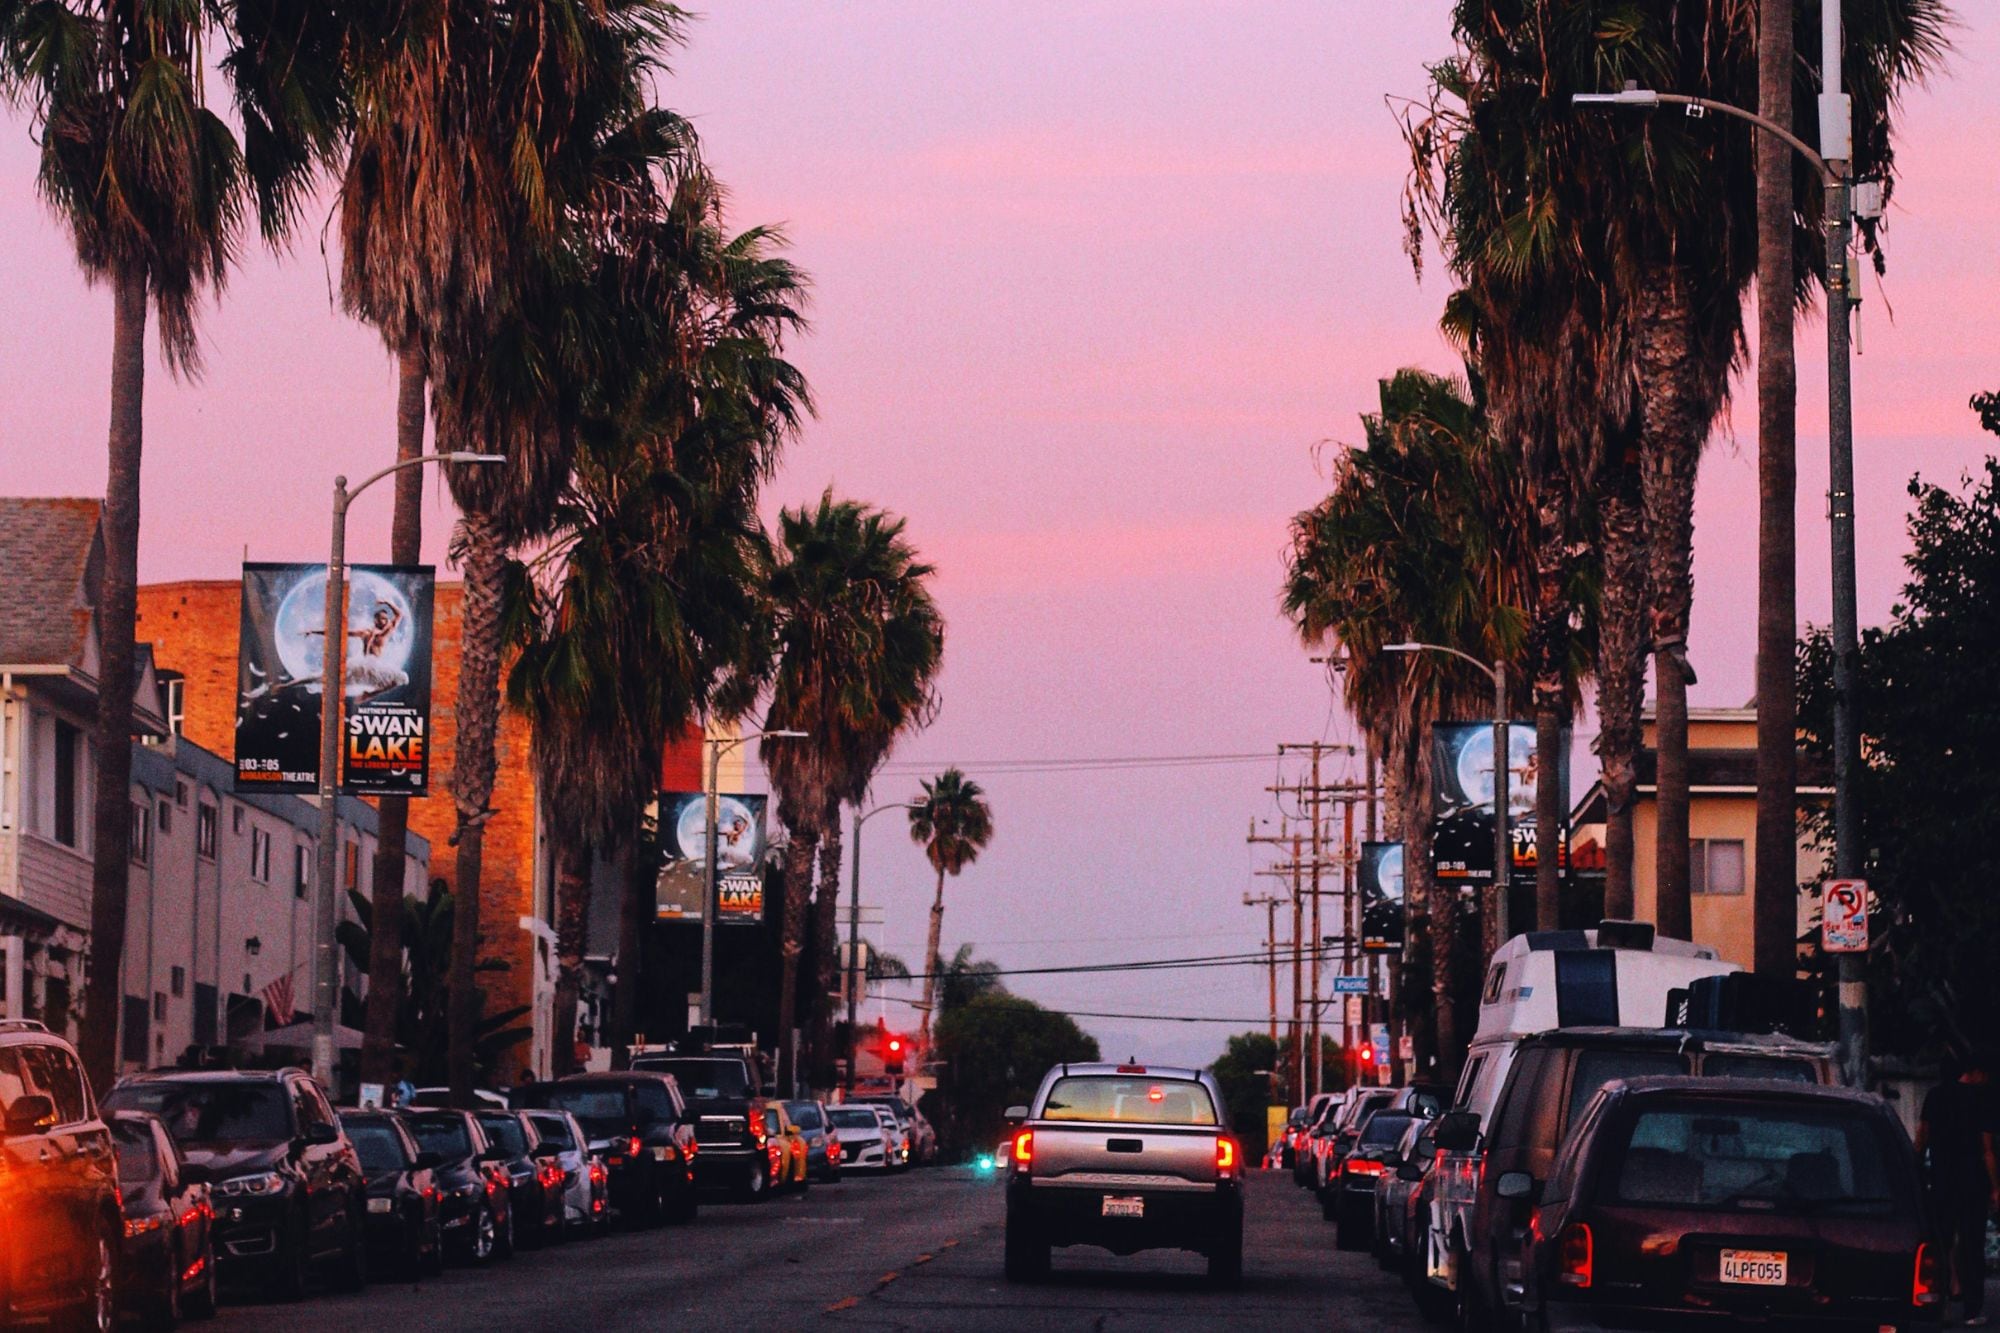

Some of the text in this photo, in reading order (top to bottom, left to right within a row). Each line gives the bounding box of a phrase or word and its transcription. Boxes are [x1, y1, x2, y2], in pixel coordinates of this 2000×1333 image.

[349, 715, 424, 736] SWAN
[350, 736, 423, 761] LAKE
[283, 772, 316, 783] THEATRE
[719, 880, 762, 892] SWAN
[719, 891, 762, 906] LAKE
[1725, 1261, 1782, 1280] 4LPF055
